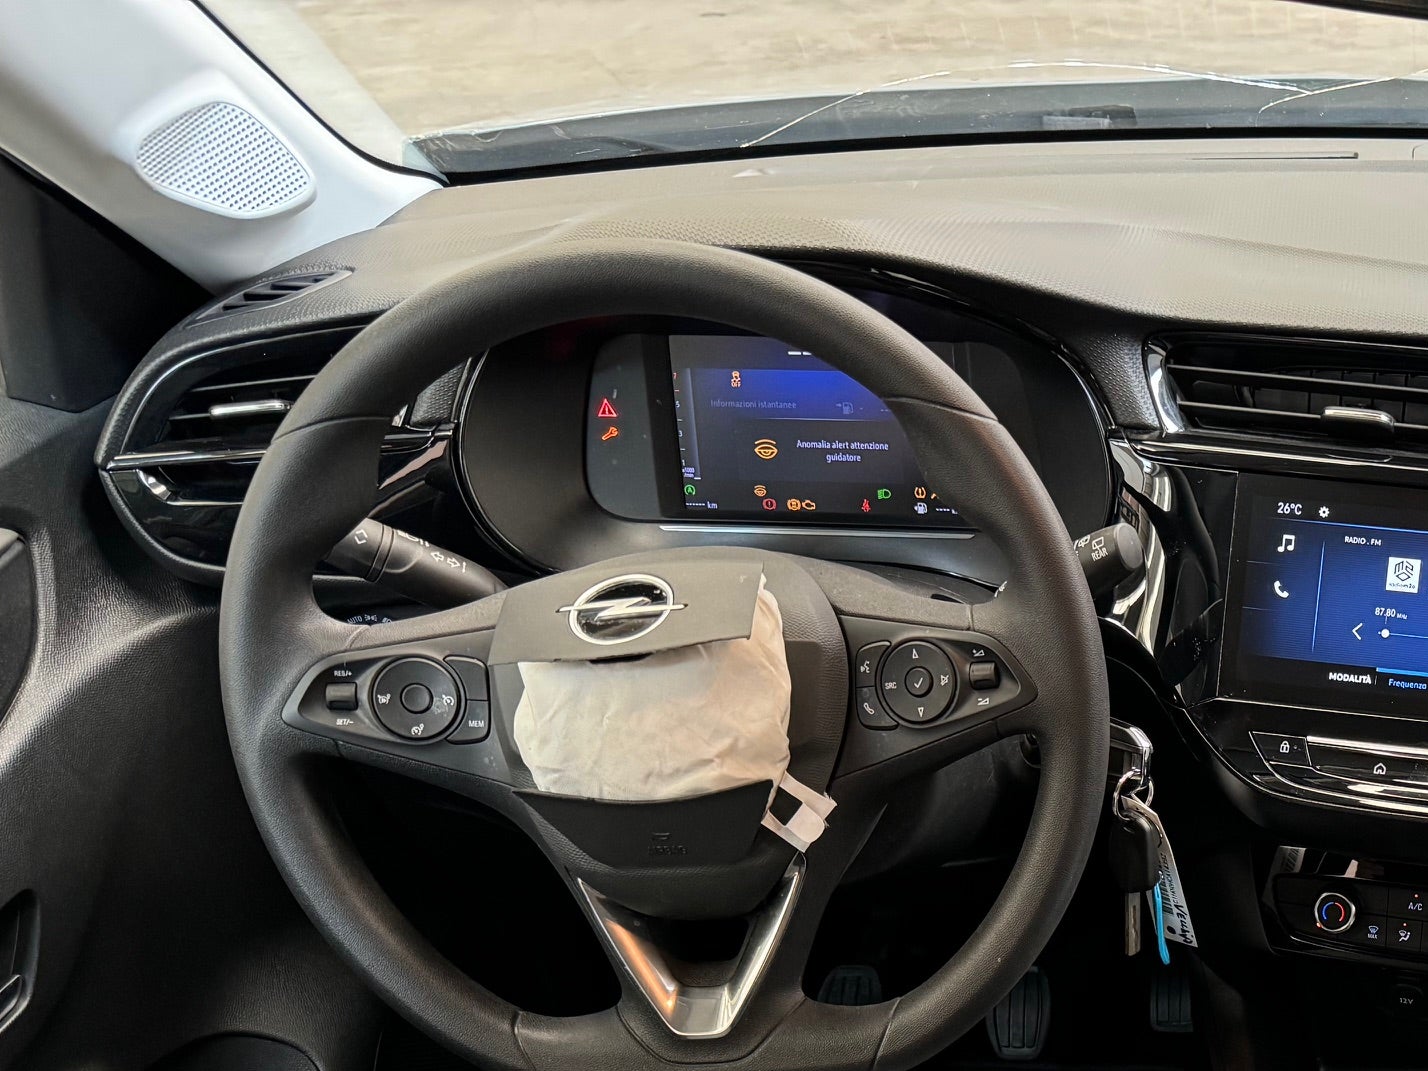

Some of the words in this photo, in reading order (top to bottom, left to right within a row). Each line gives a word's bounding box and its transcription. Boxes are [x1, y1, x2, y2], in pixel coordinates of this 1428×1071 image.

[710, 399, 757, 408] Informazioni
[758, 400, 797, 409] istantanee
[796, 440, 830, 451] Anomalia
[830, 441, 850, 450] alert
[850, 442, 889, 452] attenzione
[826, 453, 862, 463] guidatore
[707, 501, 718, 509] km
[1344, 536, 1367, 545] RADIO
[1371, 538, 1382, 546] FM
[1091, 547, 1108, 561] REAR
[1374, 607, 1396, 618] 87.80
[347, 616, 363, 624] AUTO
[1328, 669, 1372, 685] MODALITÀ
[1388, 678, 1427, 692] Frequenza
[469, 720, 484, 728] MEM
[1408, 902, 1423, 911] A/C
